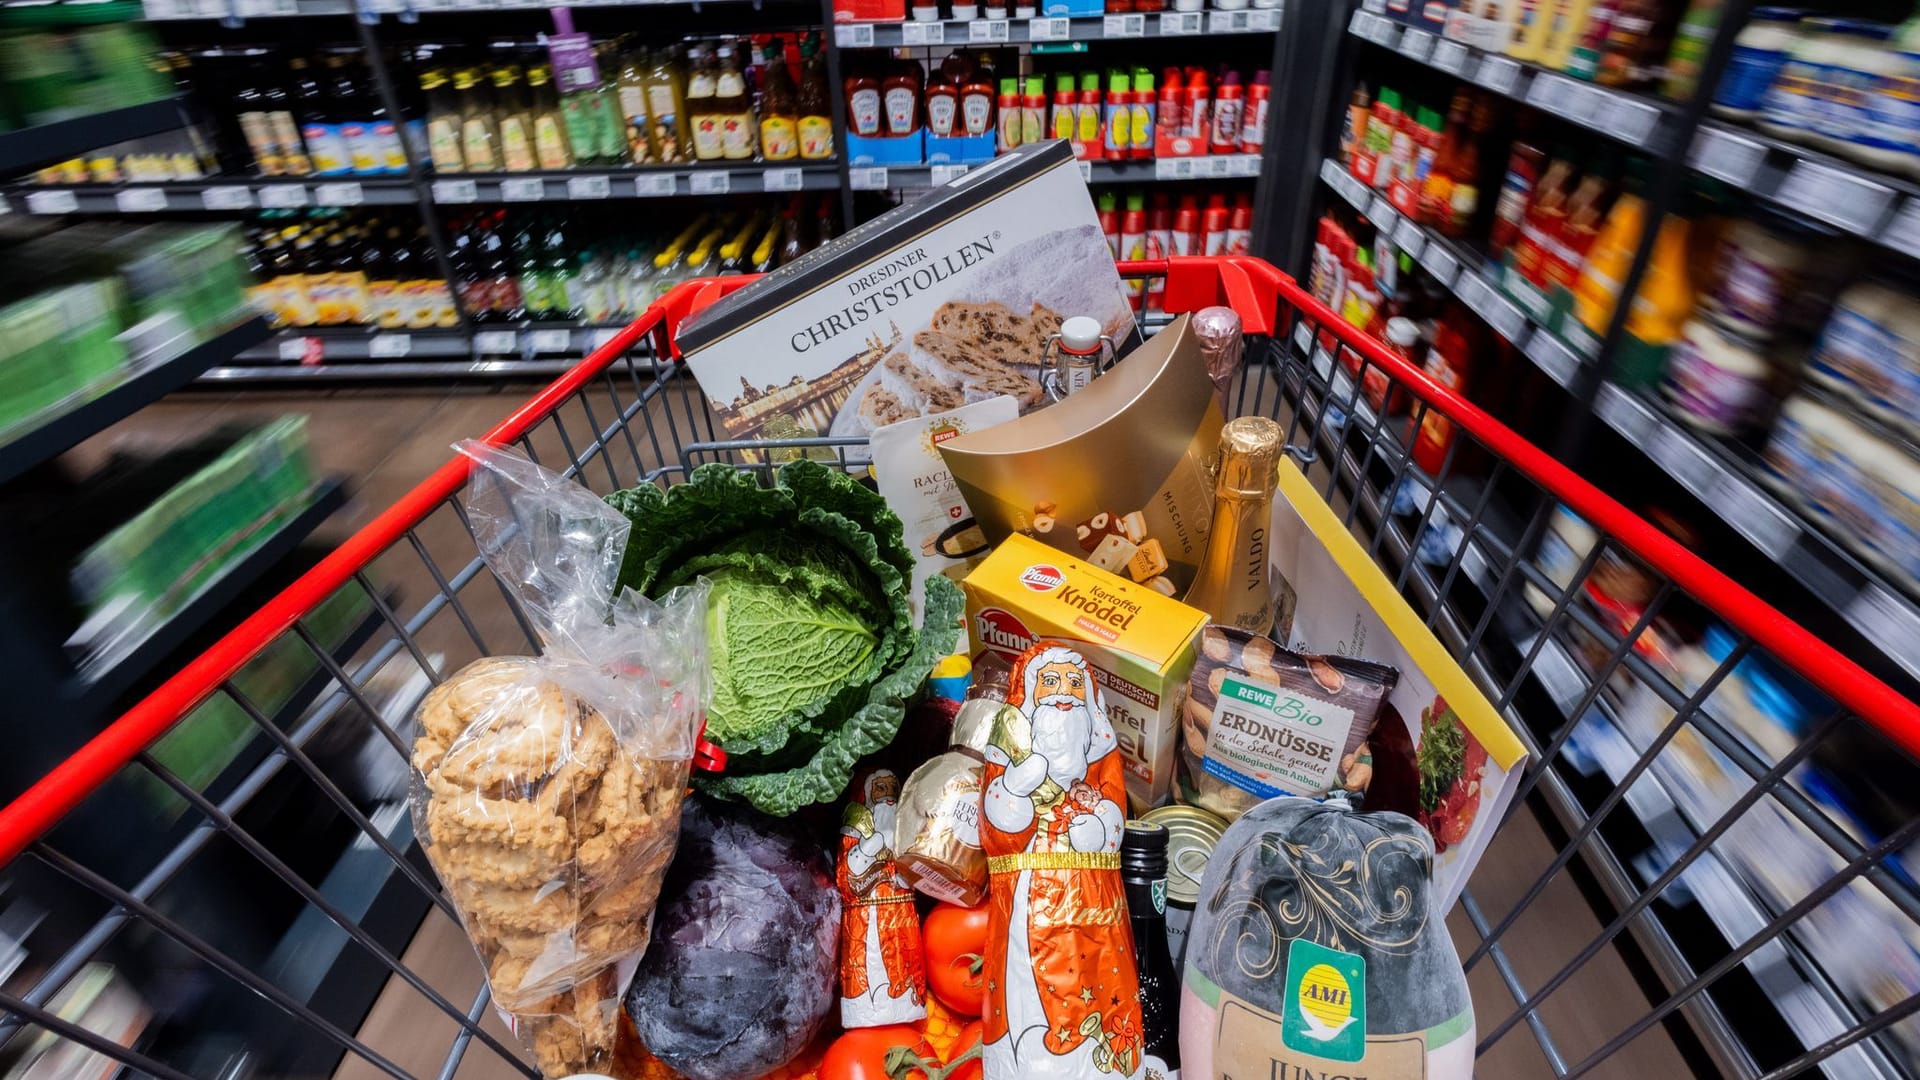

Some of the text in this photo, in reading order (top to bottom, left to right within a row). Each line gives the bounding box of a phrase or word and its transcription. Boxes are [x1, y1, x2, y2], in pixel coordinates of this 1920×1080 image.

[848, 247, 928, 296] DRESDNER
[934, 430, 956, 442] REWE
[913, 471, 953, 488] RACL
[1162, 491, 1193, 554] MISCHUNG
[1022, 567, 1065, 587] Pfanni
[1247, 528, 1265, 592] VALDO
[1056, 585, 1136, 631] Knödel
[1089, 585, 1142, 615] Kartoffel
[1109, 675, 1156, 700] DEUTSCHE
[1238, 686, 1323, 727] REWE Bio
[1214, 730, 1328, 776] in der Schale geröstet
[1218, 711, 1334, 763] ERDNÜSSE
[1212, 741, 1229, 755] Aus
[1229, 748, 1290, 777] biologischem
[1303, 983, 1348, 1006] AMI
